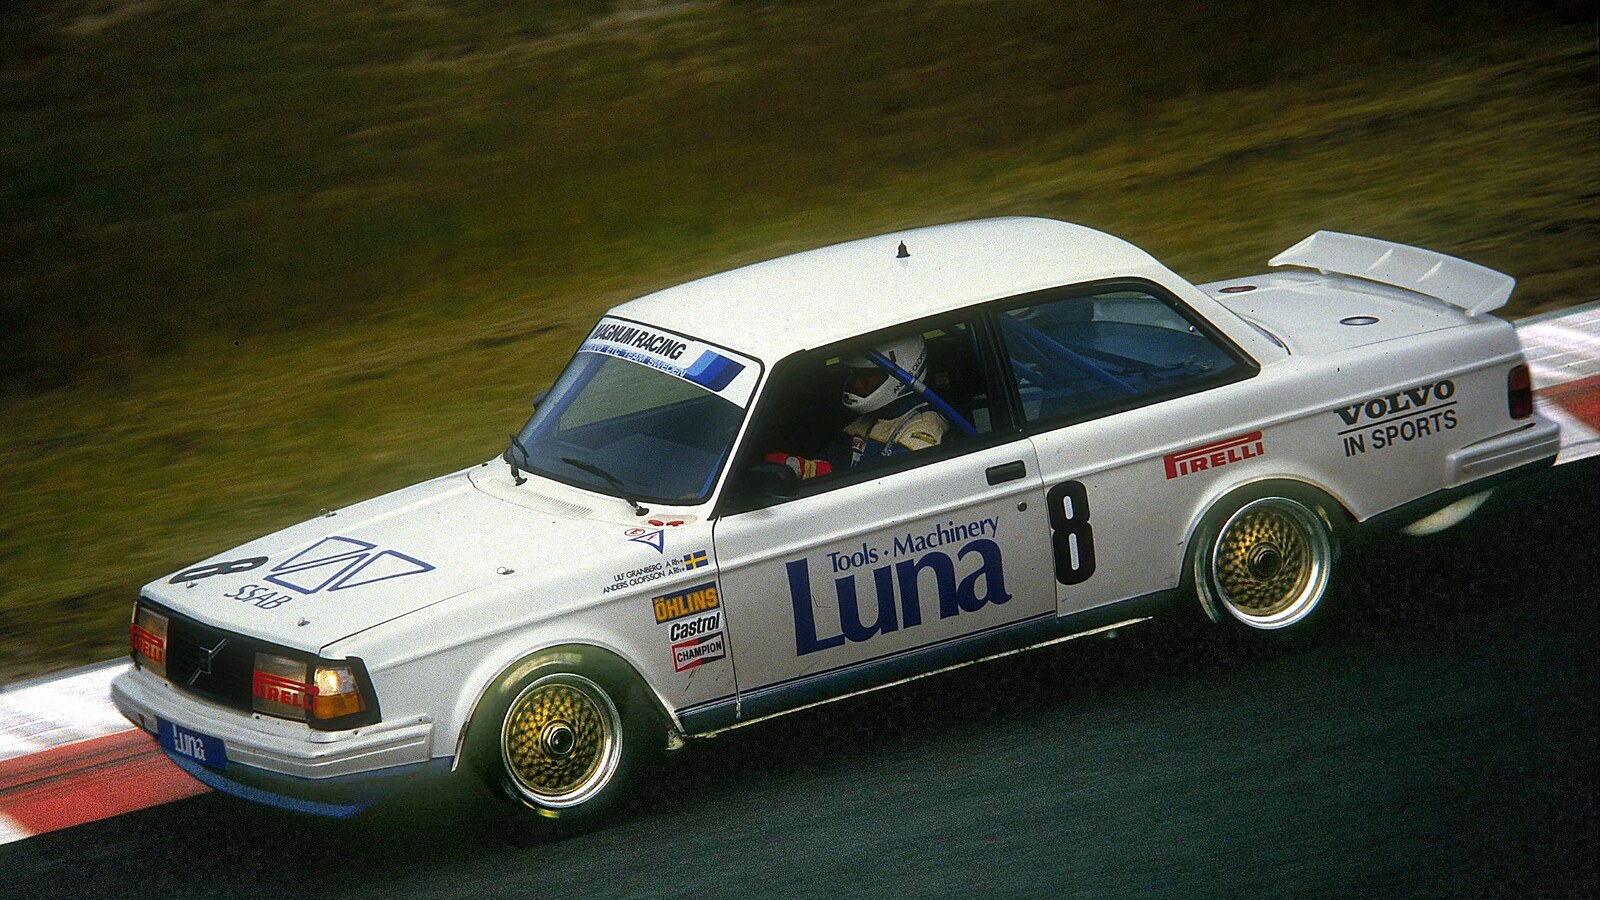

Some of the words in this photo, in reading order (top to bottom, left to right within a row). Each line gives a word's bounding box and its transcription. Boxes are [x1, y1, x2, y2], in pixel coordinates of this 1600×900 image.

[624, 349, 647, 363] TEAM
[647, 356, 688, 377] SWEDEN
[633, 330, 687, 361] RACING
[1333, 380, 1456, 426] VOLVO
[1343, 433, 1366, 458] IN
[1372, 410, 1458, 449] SPORTS
[1163, 431, 1264, 480] PIRELLI
[827, 542, 878, 574] Tools
[893, 516, 999, 558] Machinery
[1047, 480, 1096, 585] 8
[169, 556, 269, 585] 8
[602, 580, 629, 594] ANDERS
[628, 570, 666, 586] OLOFSSON
[667, 569, 674, 577] A
[613, 572, 625, 582] ULF
[626, 562, 662, 579] GRANBERG
[665, 560, 672, 568] A
[223, 584, 293, 610] SSAB
[655, 587, 719, 622] ÖHLINS
[785, 538, 1013, 658] Luna
[670, 613, 721, 642] Castrol
[677, 641, 722, 663] CHAMPION
[252, 671, 319, 714] PIRELLI
[172, 723, 207, 761] Luna
